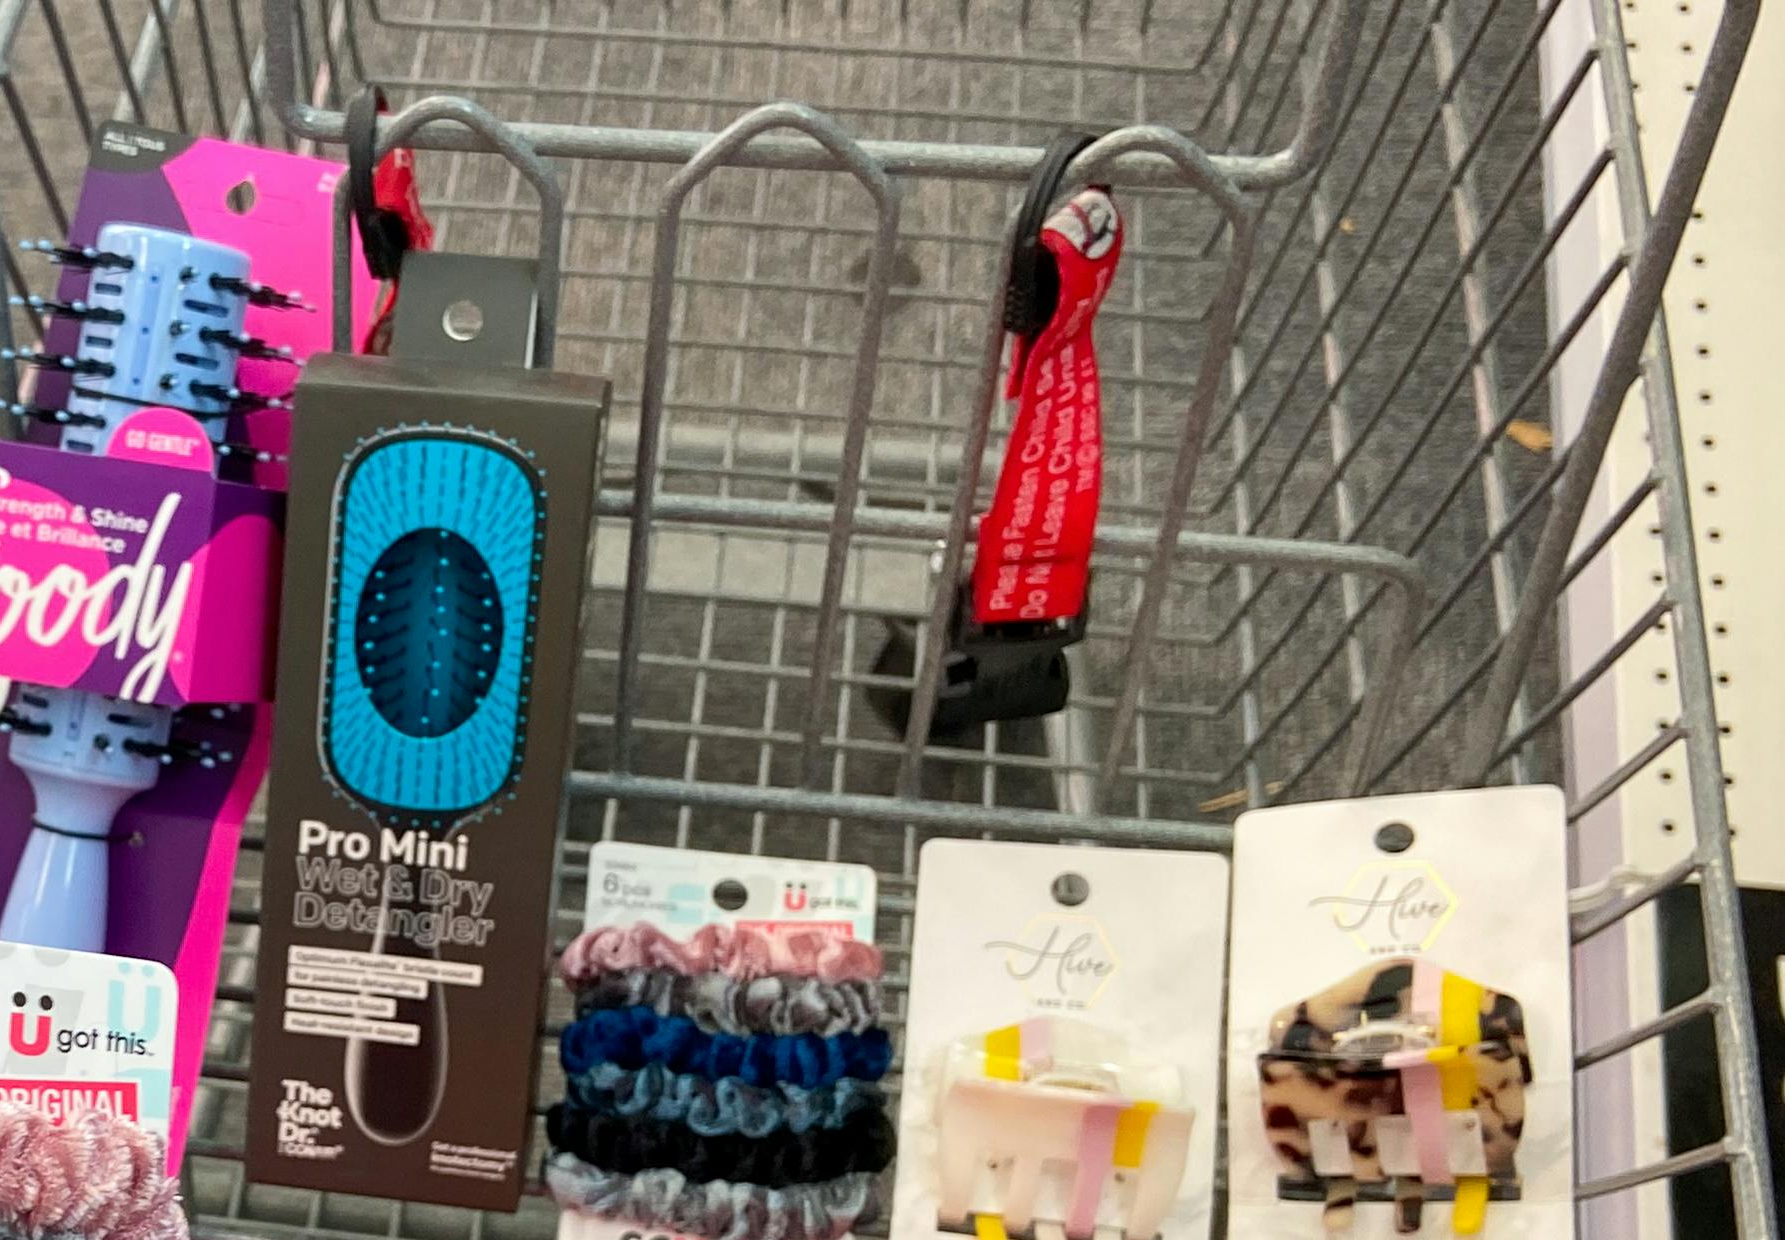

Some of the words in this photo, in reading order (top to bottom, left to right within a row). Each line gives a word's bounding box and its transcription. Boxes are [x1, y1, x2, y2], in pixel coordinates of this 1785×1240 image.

[10, 521, 33, 541] et
[36, 523, 127, 553] Brillance
[70, 504, 86, 525] &
[91, 508, 149, 533] Shine
[299, 819, 371, 860] Pro
[380, 828, 468, 872] Mini
[295, 855, 379, 898] Wet
[385, 864, 415, 902] &
[419, 868, 494, 918] Dry
[783, 881, 808, 911] Ü
[1307, 874, 1449, 940] Hive
[293, 891, 495, 948] Detangler
[983, 926, 1113, 995] Hive
[8, 991, 53, 1057] Ü
[57, 1028, 99, 1053] got
[105, 1029, 146, 1055] this
[275, 1100, 344, 1129] Knot
[281, 1078, 334, 1107] The
